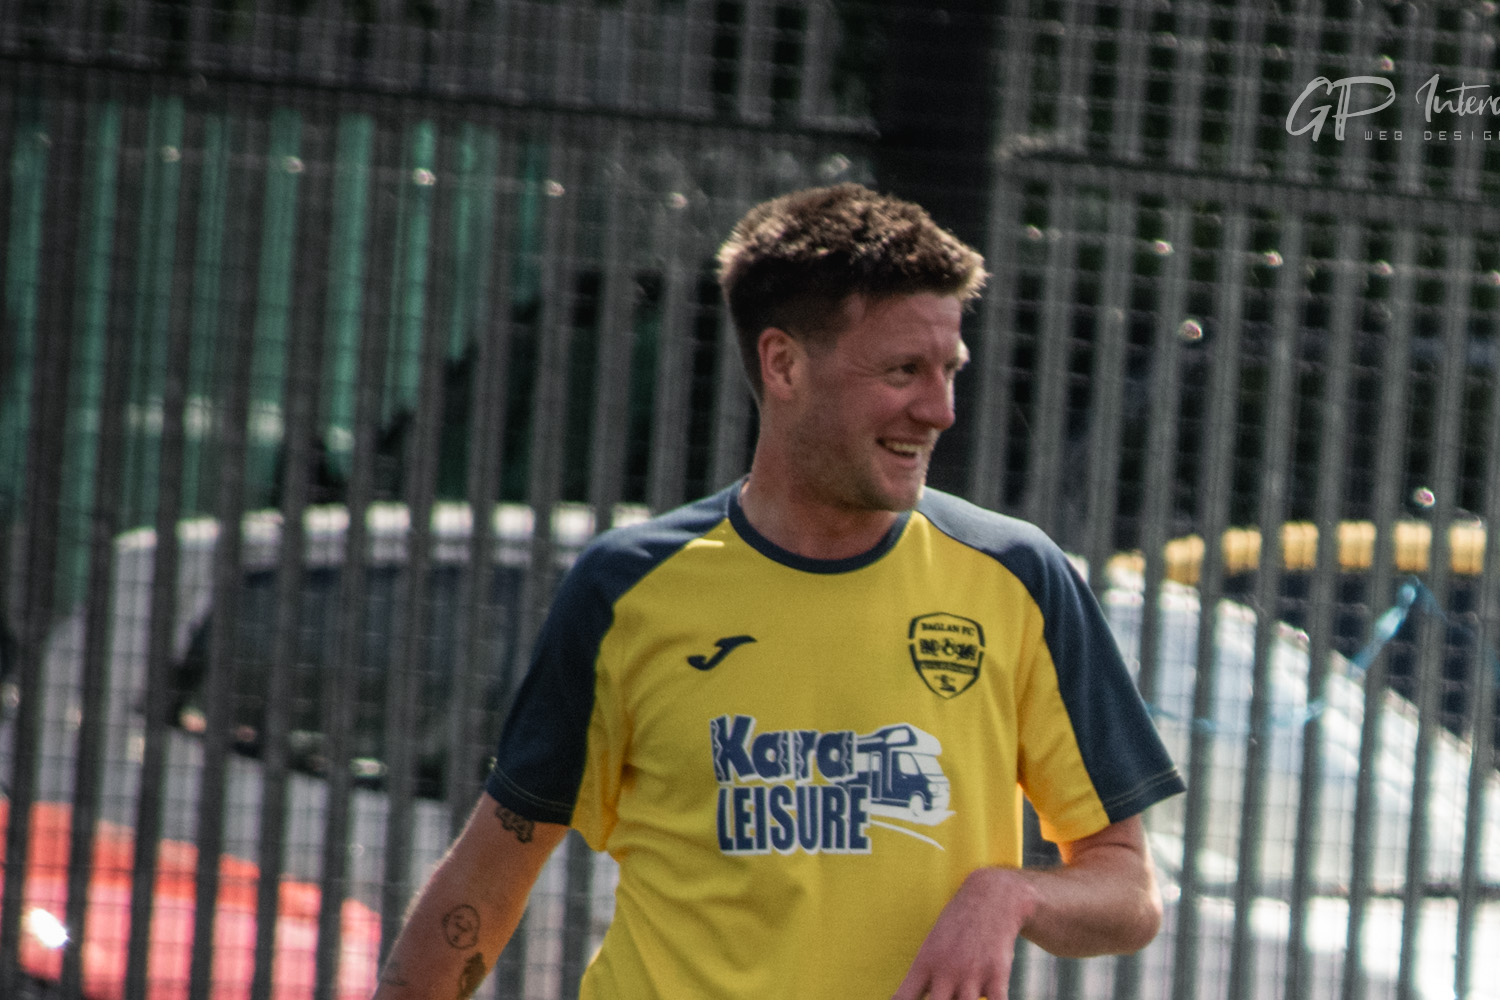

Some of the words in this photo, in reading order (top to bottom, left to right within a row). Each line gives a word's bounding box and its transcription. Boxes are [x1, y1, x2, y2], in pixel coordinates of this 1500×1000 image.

[921, 622, 960, 632] BAGLAN
[961, 626, 976, 636] FC
[709, 714, 857, 783] Kara
[716, 784, 872, 855] LEISURE
